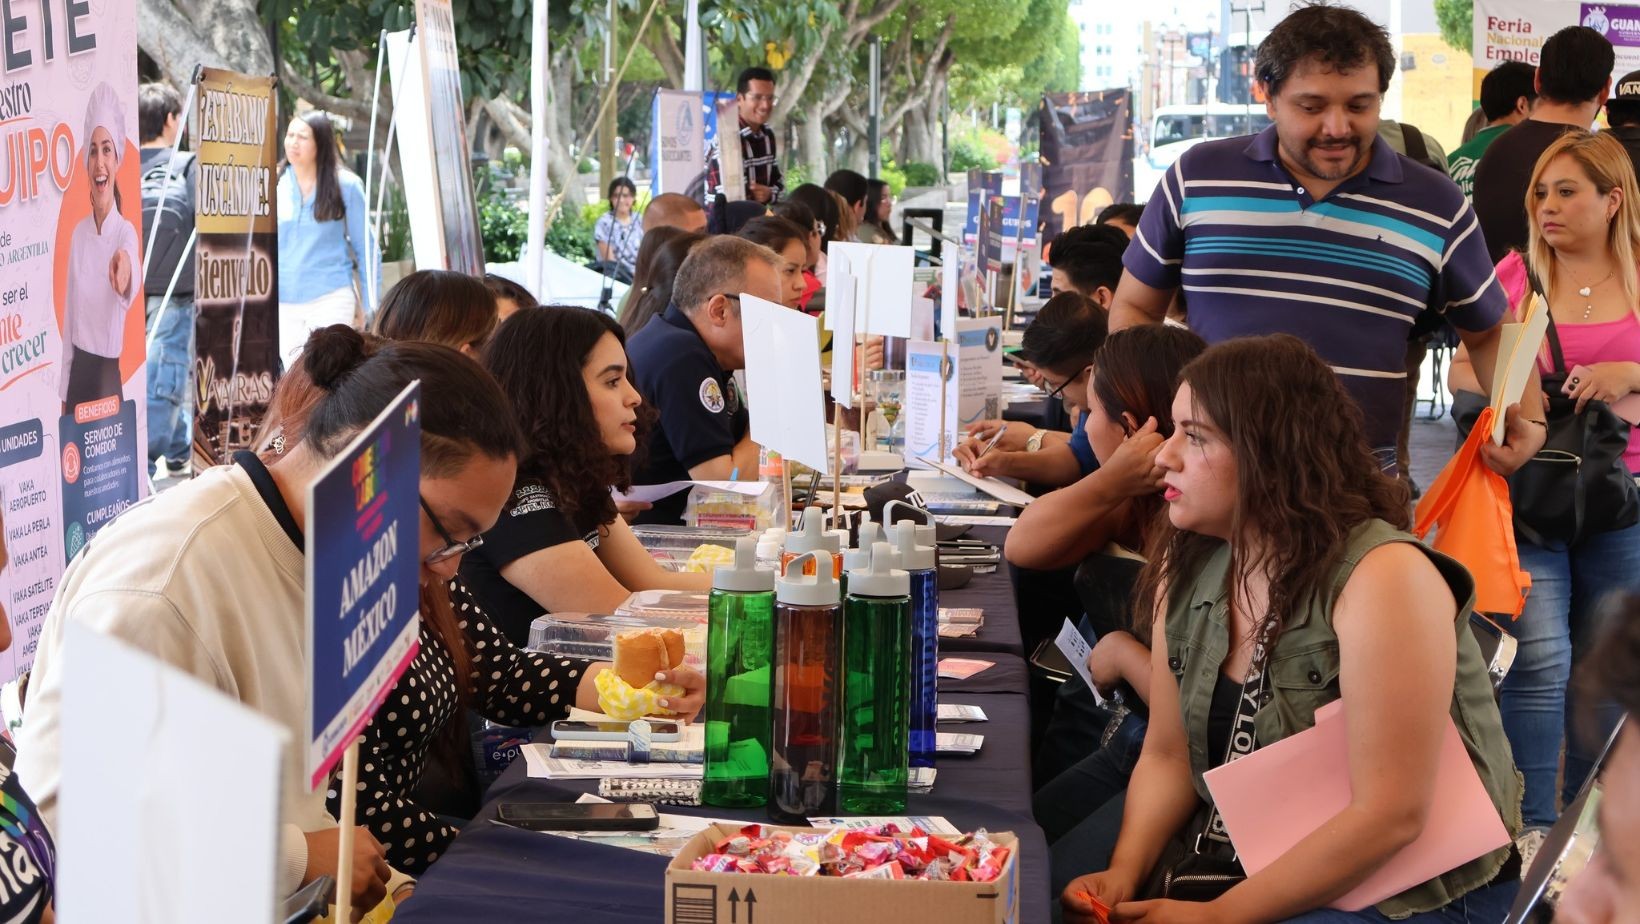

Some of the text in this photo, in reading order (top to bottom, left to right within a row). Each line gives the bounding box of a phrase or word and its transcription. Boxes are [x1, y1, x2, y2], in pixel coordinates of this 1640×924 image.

[1487, 16, 1532, 34] Feria
[1487, 32, 1543, 48] Nacional
[2, 281, 29, 306] ser el
[1, 331, 47, 374] crecer
[78, 400, 117, 420] BENEFICIOS
[1, 430, 38, 453] UNIDADES
[84, 422, 123, 445] SERVICIO DE
[85, 438, 117, 459] COMEDOR
[18, 479, 35, 494] VAKA
[9, 489, 47, 513] AEROPUERTO
[86, 499, 130, 525] CUMPLEAÑOS
[9, 516, 51, 541] VAKA LA PERLA
[13, 551, 29, 568] VAKA
[339, 520, 398, 619] AMAZON
[13, 587, 27, 604] VAKA
[342, 582, 397, 678] MÉXICO
